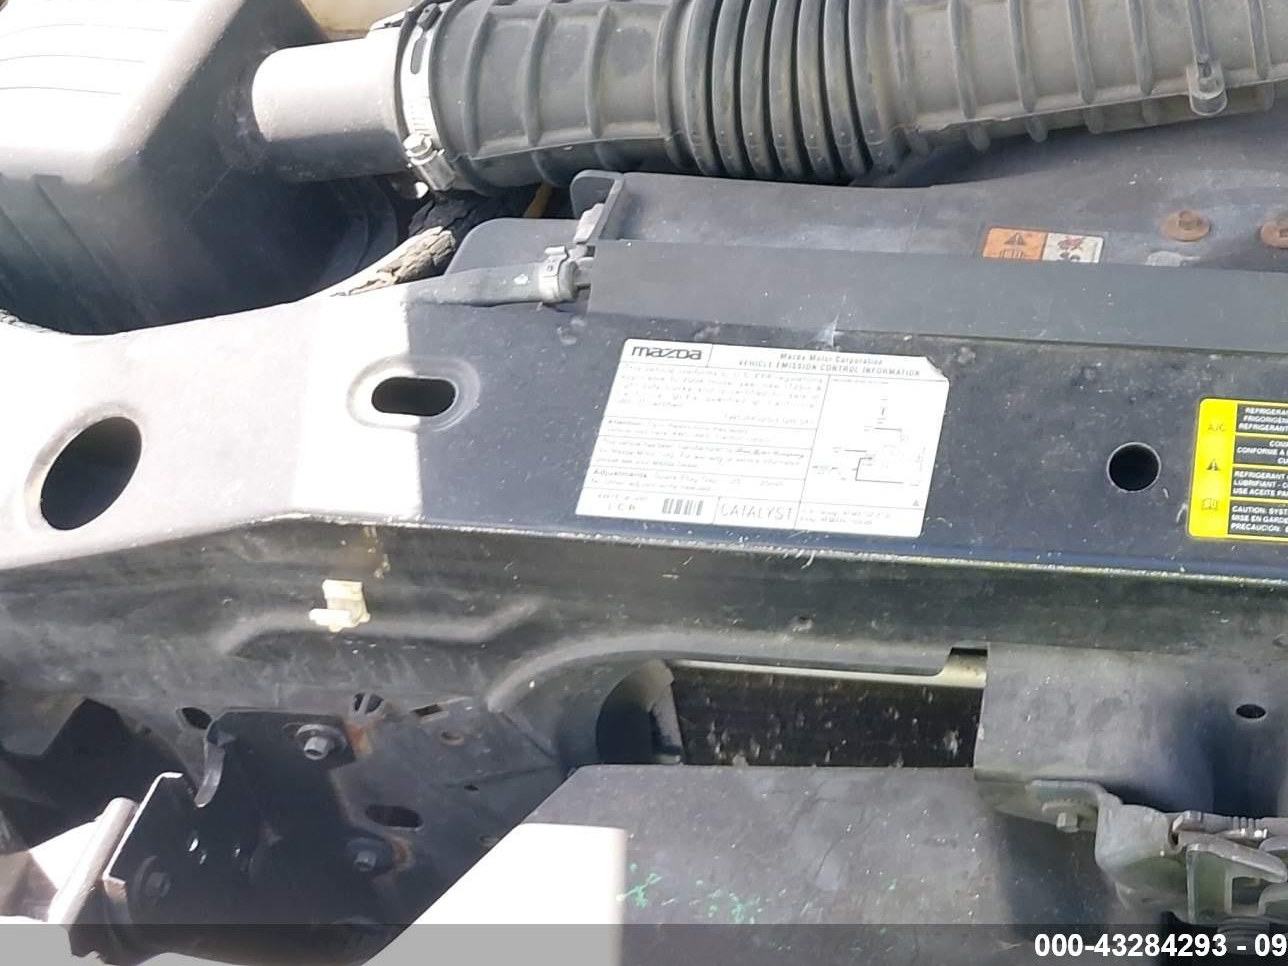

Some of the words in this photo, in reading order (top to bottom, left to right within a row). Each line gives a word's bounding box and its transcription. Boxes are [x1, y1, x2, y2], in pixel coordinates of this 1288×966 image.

[631, 345, 702, 360] mazda
[776, 362, 817, 371] EMISSION
[820, 364, 859, 373] CONTROL
[863, 367, 920, 377] INFORMATION
[720, 503, 793, 520] CATALYST
